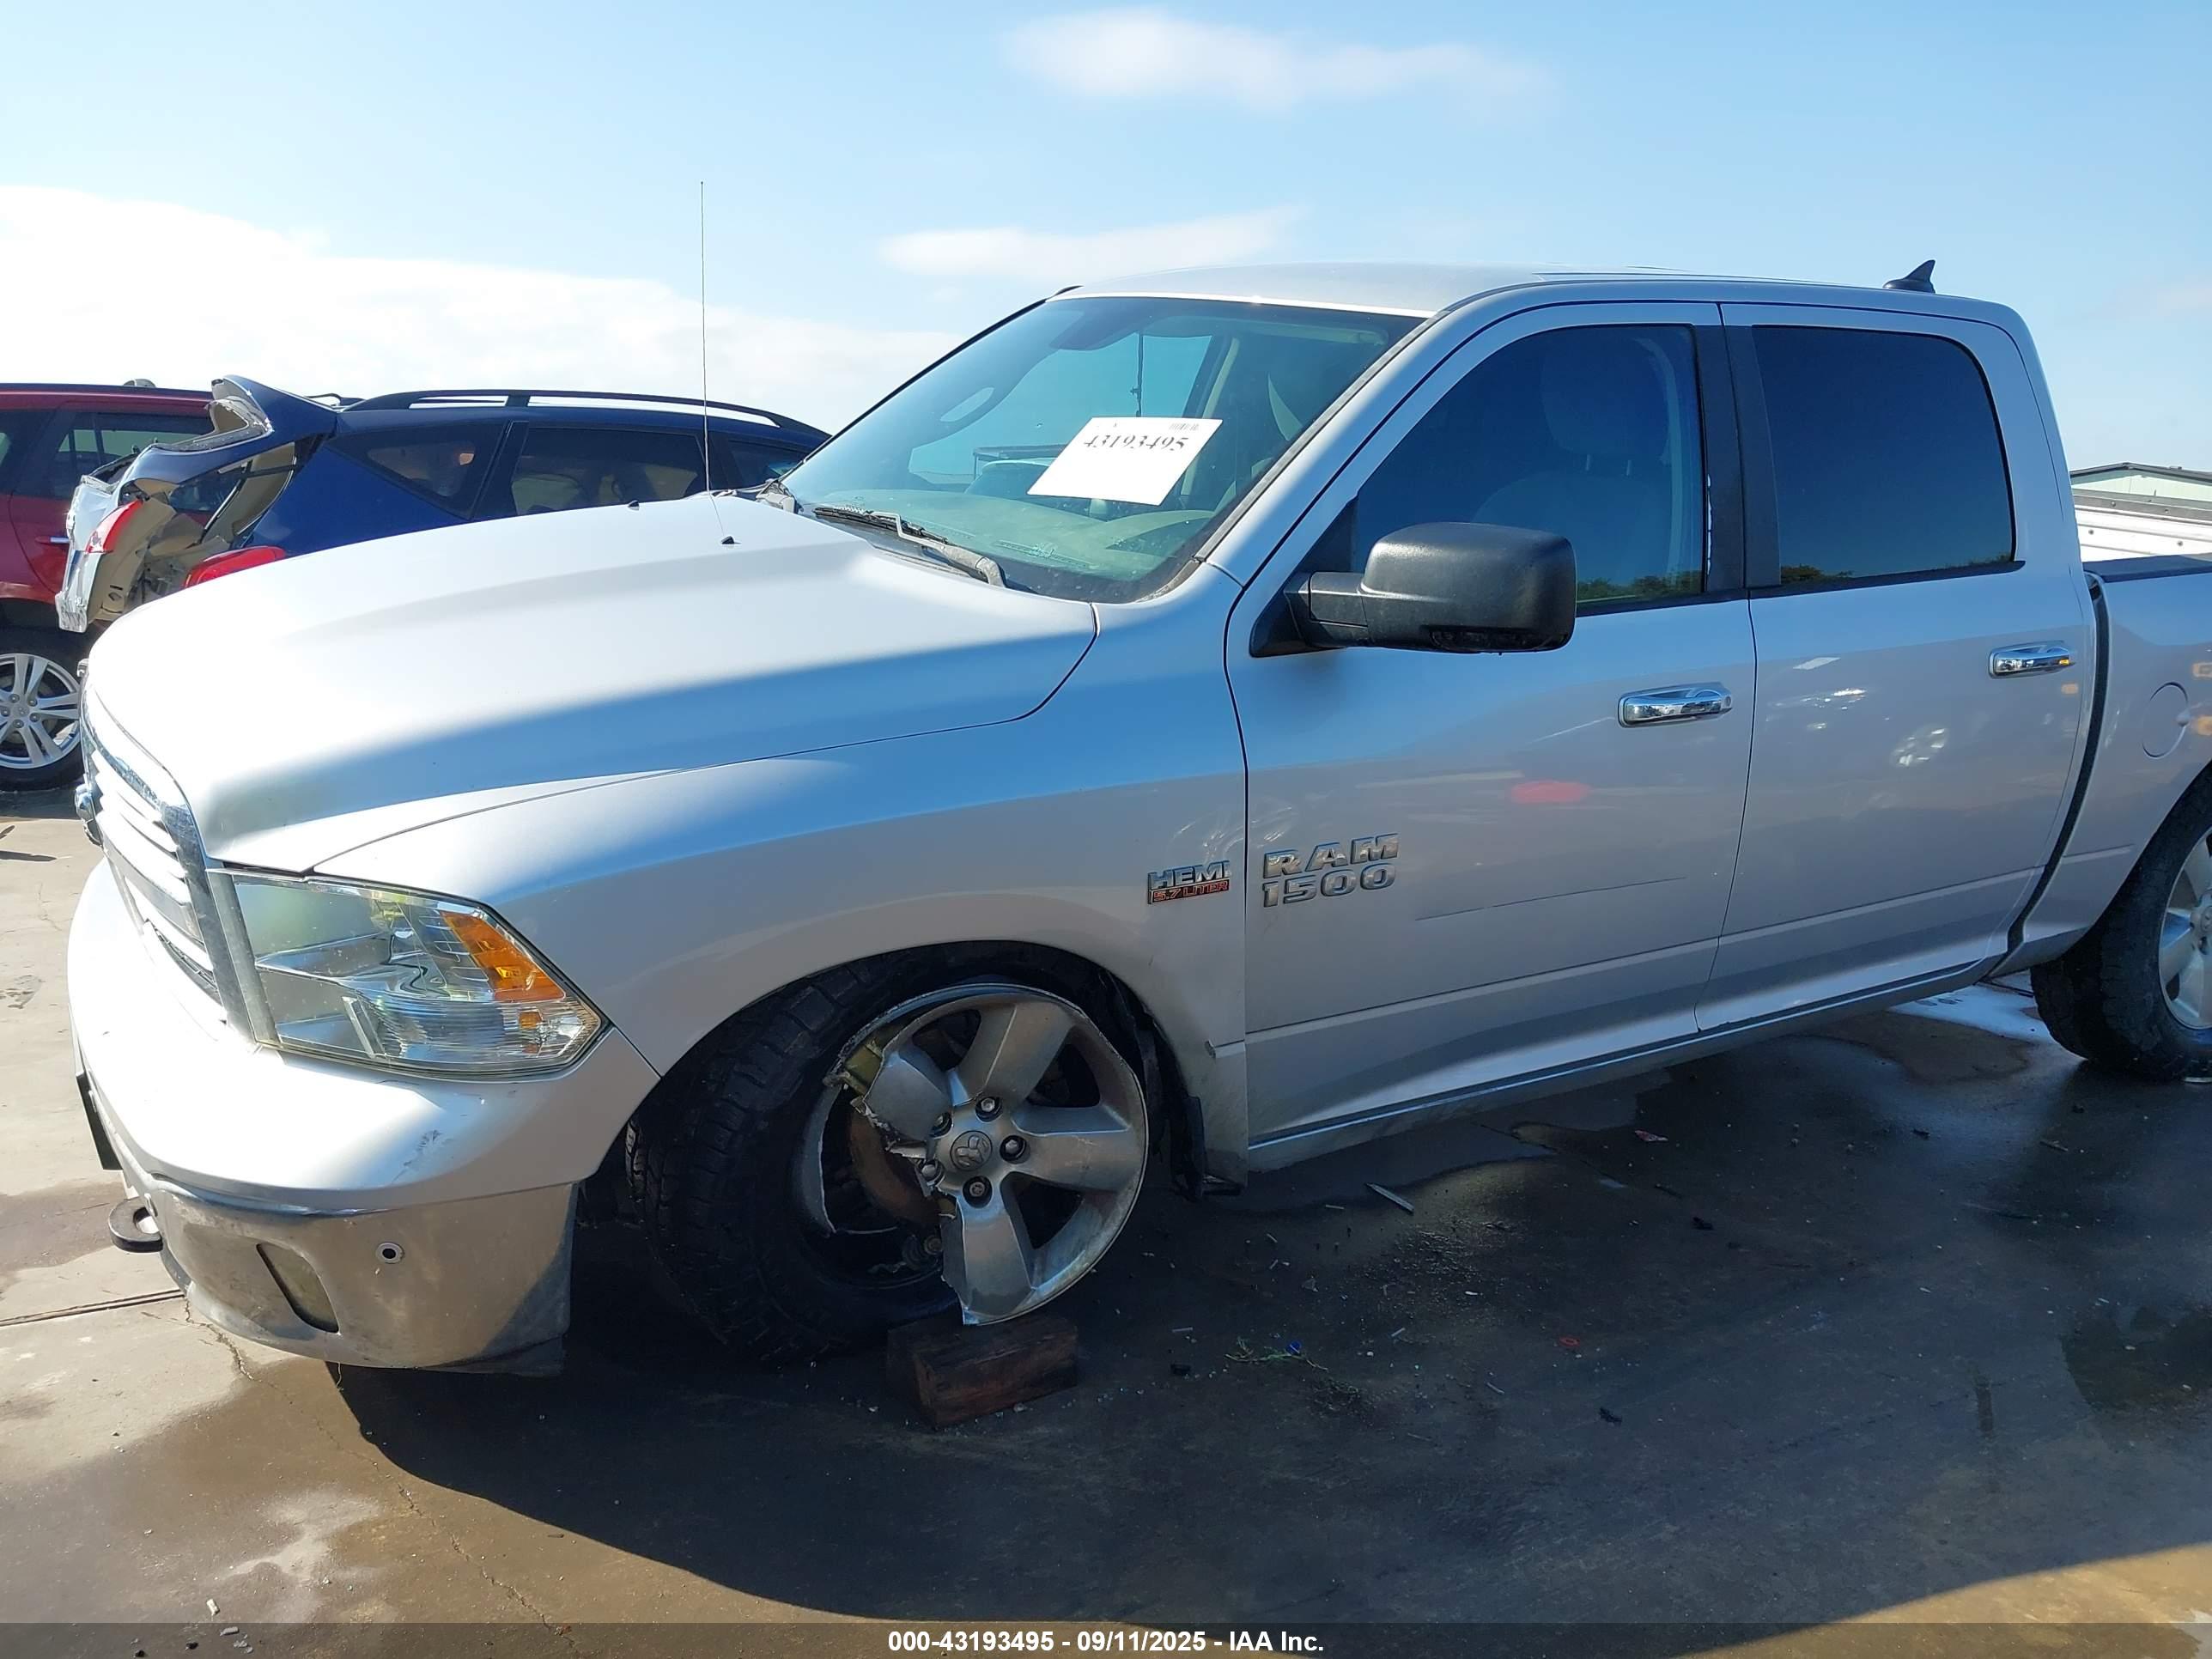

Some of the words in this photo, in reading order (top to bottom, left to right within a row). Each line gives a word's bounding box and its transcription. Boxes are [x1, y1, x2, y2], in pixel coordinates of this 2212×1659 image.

[1084, 434, 1189, 451] 43193495
[1263, 833, 1400, 879] RAM
[1148, 860, 1231, 889] HEMI
[1262, 863, 1396, 908] 1500
[1153, 888, 1181, 902] 5.7
[1182, 880, 1229, 897] LITER
